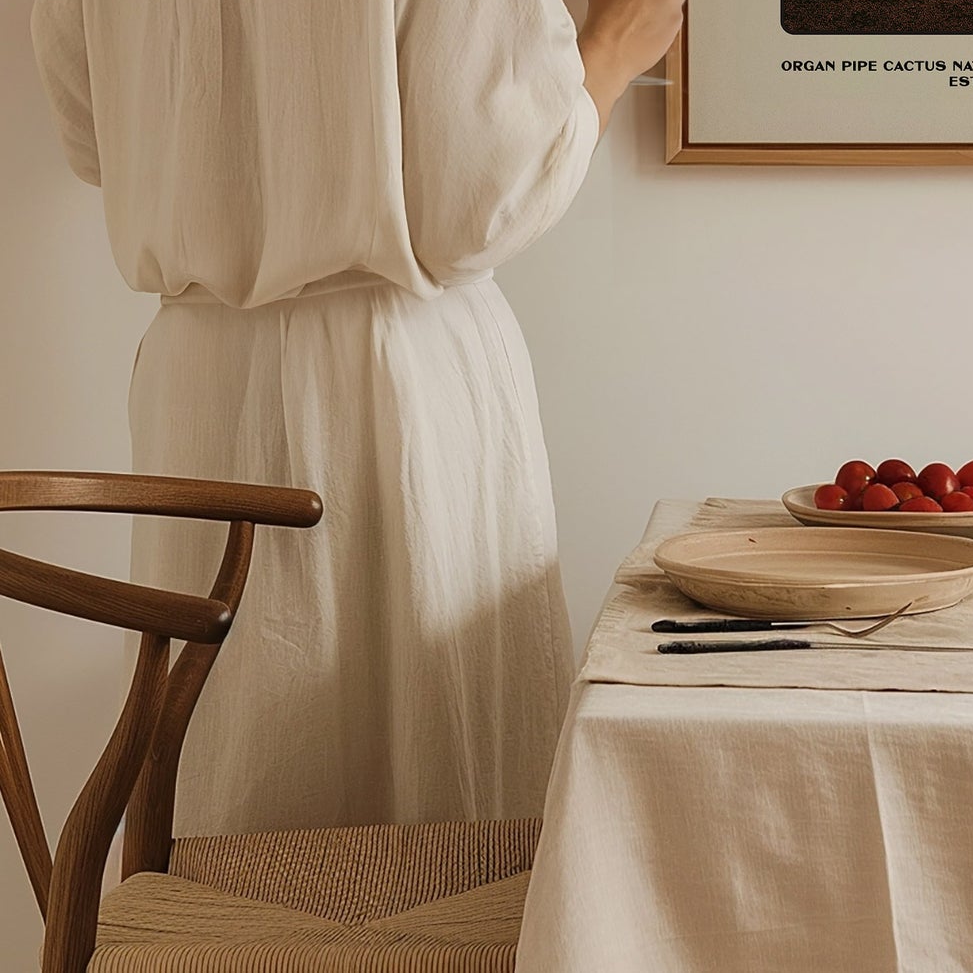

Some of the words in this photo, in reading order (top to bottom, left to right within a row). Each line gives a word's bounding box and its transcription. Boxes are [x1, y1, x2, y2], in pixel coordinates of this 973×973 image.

[780, 60, 836, 72] ORGAN
[841, 60, 878, 72] PIPE
[882, 60, 947, 72] CACTUS
